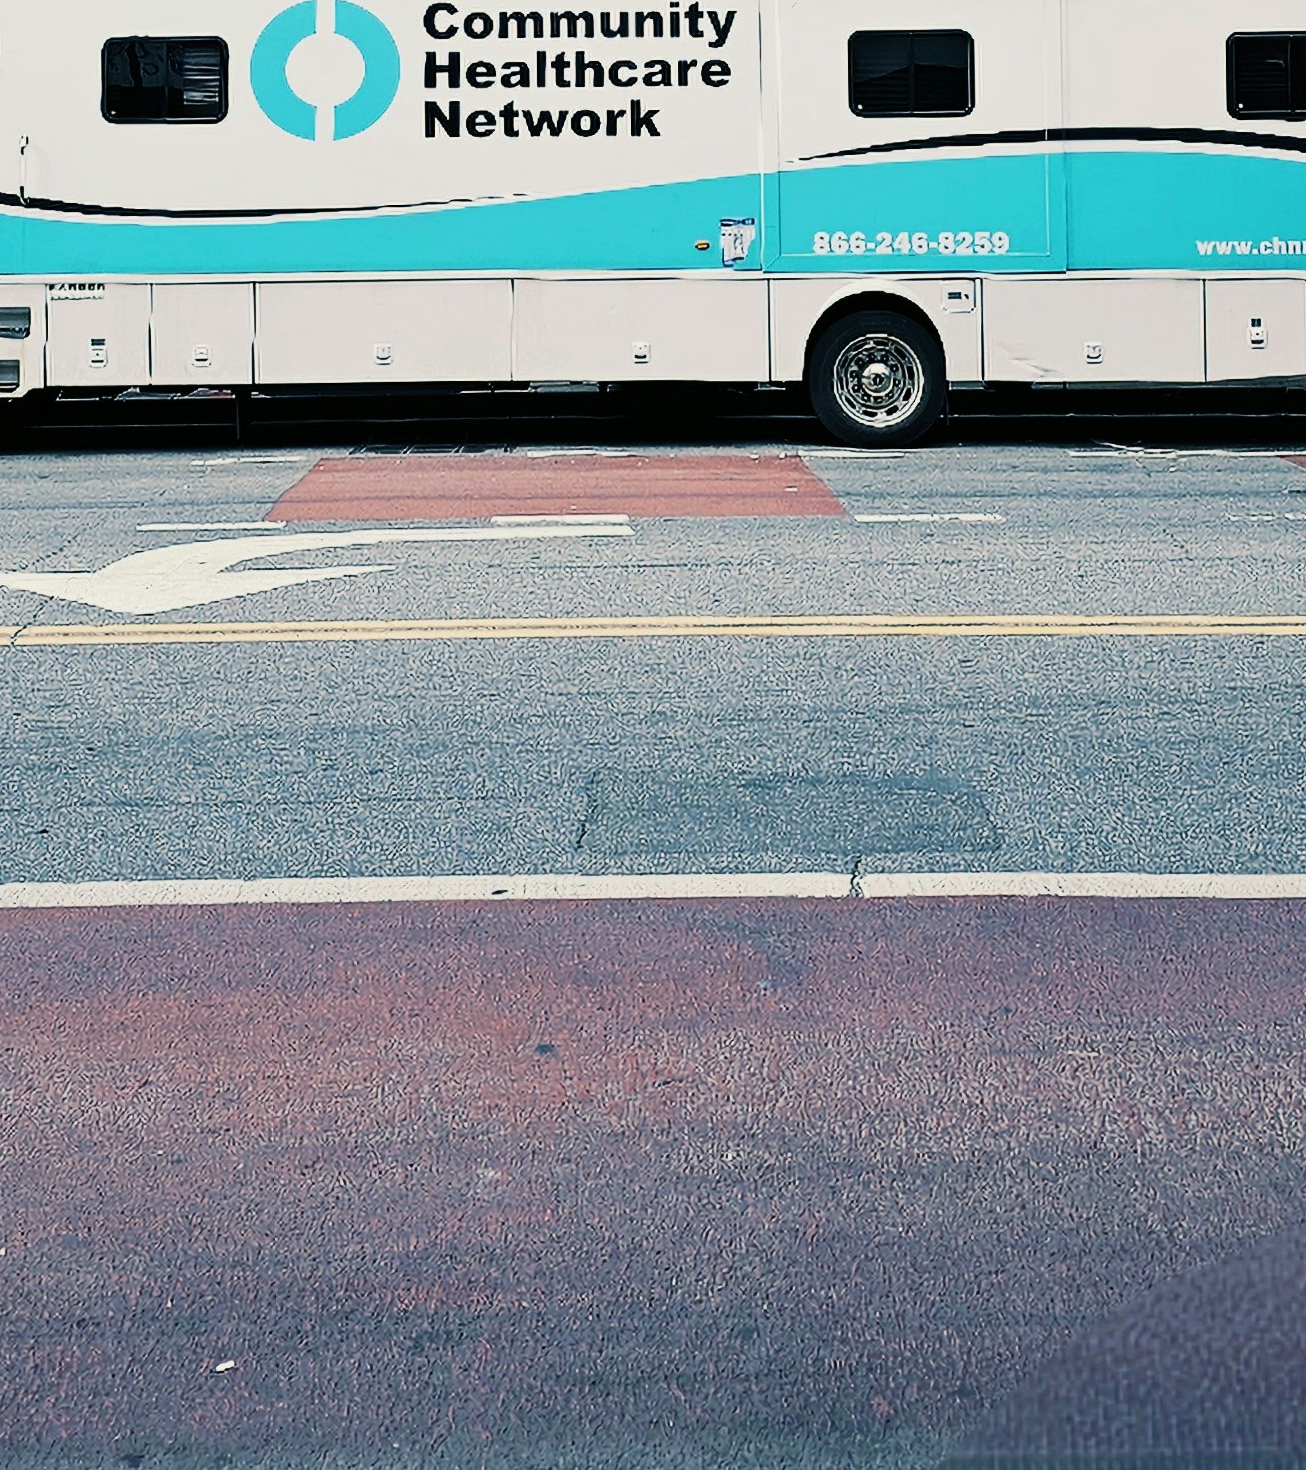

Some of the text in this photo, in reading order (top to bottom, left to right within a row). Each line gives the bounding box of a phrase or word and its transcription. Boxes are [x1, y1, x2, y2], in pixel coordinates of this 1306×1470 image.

[423, 1, 737, 49] Community
[424, 50, 732, 88] Healthcare
[424, 99, 661, 138] Network
[812, 230, 1010, 255] 866-246-8259
